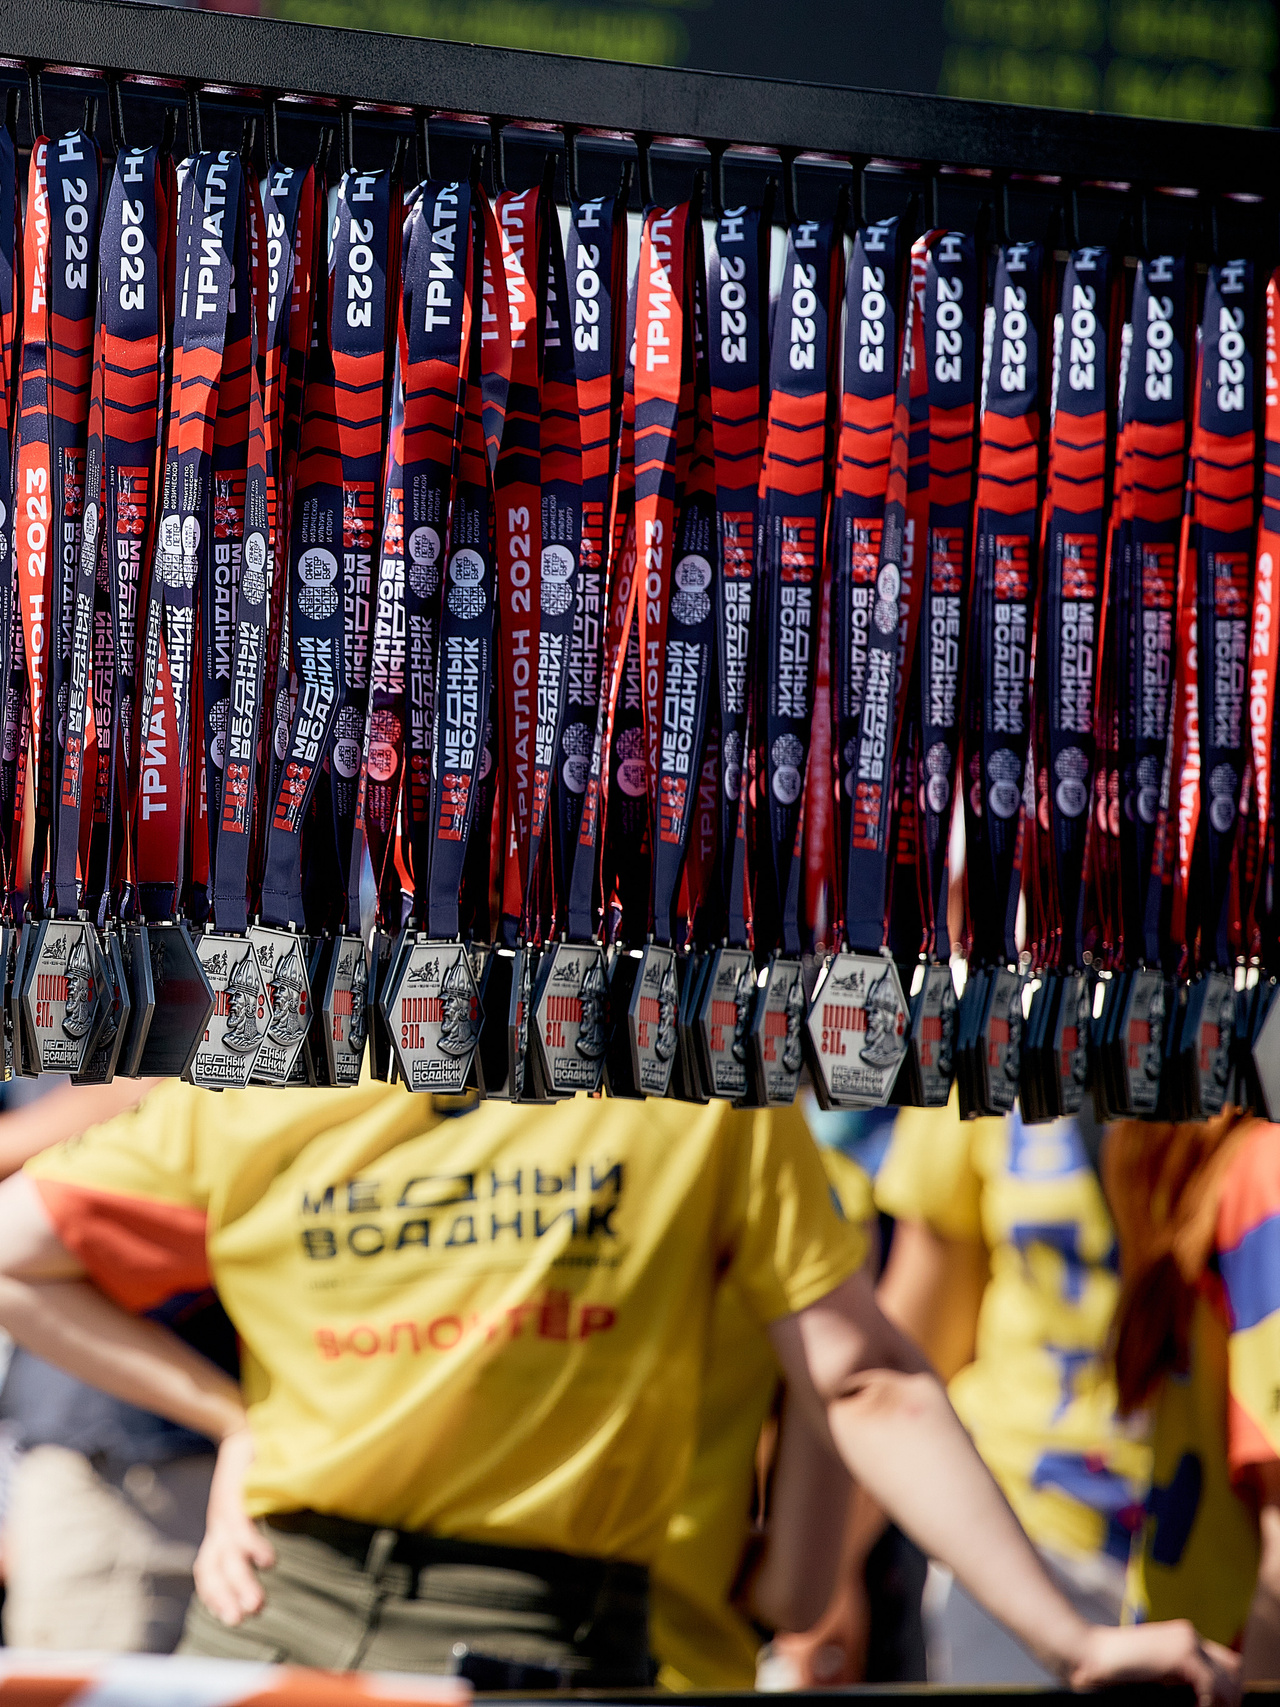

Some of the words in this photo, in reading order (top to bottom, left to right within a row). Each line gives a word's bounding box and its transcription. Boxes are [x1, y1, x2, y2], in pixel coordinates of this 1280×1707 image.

[61, 178, 89, 290] 2023
[120, 199, 145, 312] 2023
[346, 218, 374, 328] 2023
[425, 182, 458, 333] ТРИАТЛ
[574, 243, 600, 353] 2023
[646, 205, 677, 373] ТРИАТЛ
[720, 256, 748, 365] 2023
[789, 263, 818, 371] 2023
[858, 265, 886, 373] 2023
[934, 276, 963, 383] 2023
[999, 285, 1028, 393] 2023
[1069, 284, 1096, 391] 2023
[1145, 295, 1174, 402] 2023
[1217, 306, 1246, 413] 2023
[26, 467, 48, 578] 2023
[508, 505, 531, 614] 2023
[644, 519, 664, 625] 2023
[62, 522, 76, 660] ВСАДНИК
[116, 539, 130, 677] ВСАДНИК
[214, 543, 230, 680] ВСАДНИК
[353, 554, 372, 690] МЕДНЫЙ
[373, 559, 397, 693] ВСАДНИК
[582, 573, 600, 707] МЕДНЫЙ
[724, 581, 738, 714] ВСАДНИК
[777, 586, 796, 718] ВСАДНИК
[792, 587, 812, 720] МЕДНЫЙ
[230, 621, 251, 759] МЕДНЫЙ
[241, 624, 260, 760] ВСАДНИК
[292, 636, 320, 760] МЕДНЫЙ
[304, 637, 335, 763] ВСАДНИК
[444, 636, 463, 769] МЕДНЫЙ
[460, 637, 480, 770] ВСАДНИК
[543, 633, 564, 766] ВСАДНИК
[661, 640, 685, 772] МЕДНЫЙ
[676, 642, 701, 775] ВСАДНИК
[930, 596, 947, 728] ВСАДНИК
[993, 603, 1011, 734] ВСАДНИК
[1009, 603, 1027, 735] МЕДНЫЙ
[1061, 602, 1079, 731] ВСАДНИК
[1077, 602, 1095, 734] МЕДНЫЙ
[510, 629, 531, 842] ТРИАТЛОН
[196, 1053, 247, 1066] МЕДНЫЙ
[196, 1063, 246, 1077] ВСАДНИК
[412, 1058, 461, 1071] МЕДНЫЙ
[412, 1070, 461, 1083] ВСАДНИК
[300, 1203, 622, 1262] ВСАДНИК
[301, 1157, 626, 1216] МЕДНЫЙ
